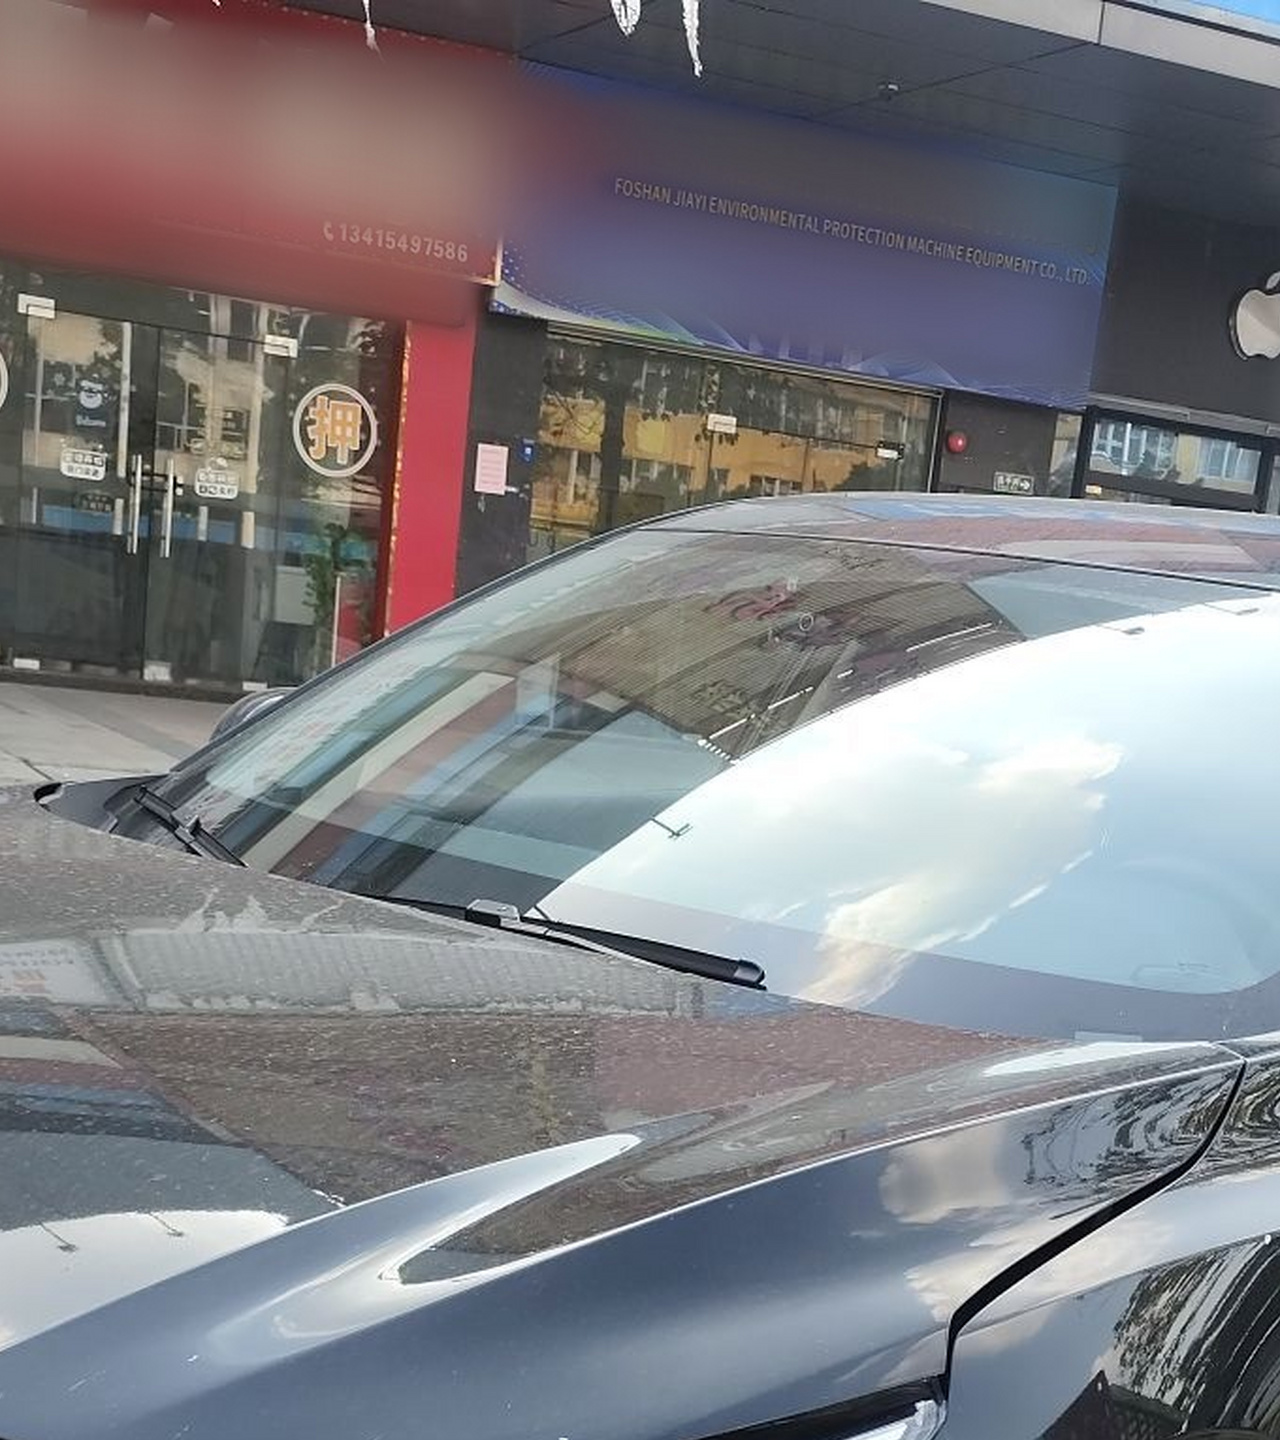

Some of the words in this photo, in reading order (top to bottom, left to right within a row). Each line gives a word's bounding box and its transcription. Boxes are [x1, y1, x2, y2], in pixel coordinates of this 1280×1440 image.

[339, 223, 468, 263] 13415497586
[614, 177, 671, 204] FOSHAN
[673, 190, 708, 212] JIAYI
[708, 195, 821, 234] ENVIRONMENTAL
[822, 218, 905, 251] PROTECTION
[906, 235, 965, 262] MACHINE
[965, 246, 1039, 276] EQUIPMENT
[1064, 267, 1091, 286] LTD.
[306, 394, 362, 466] 押
